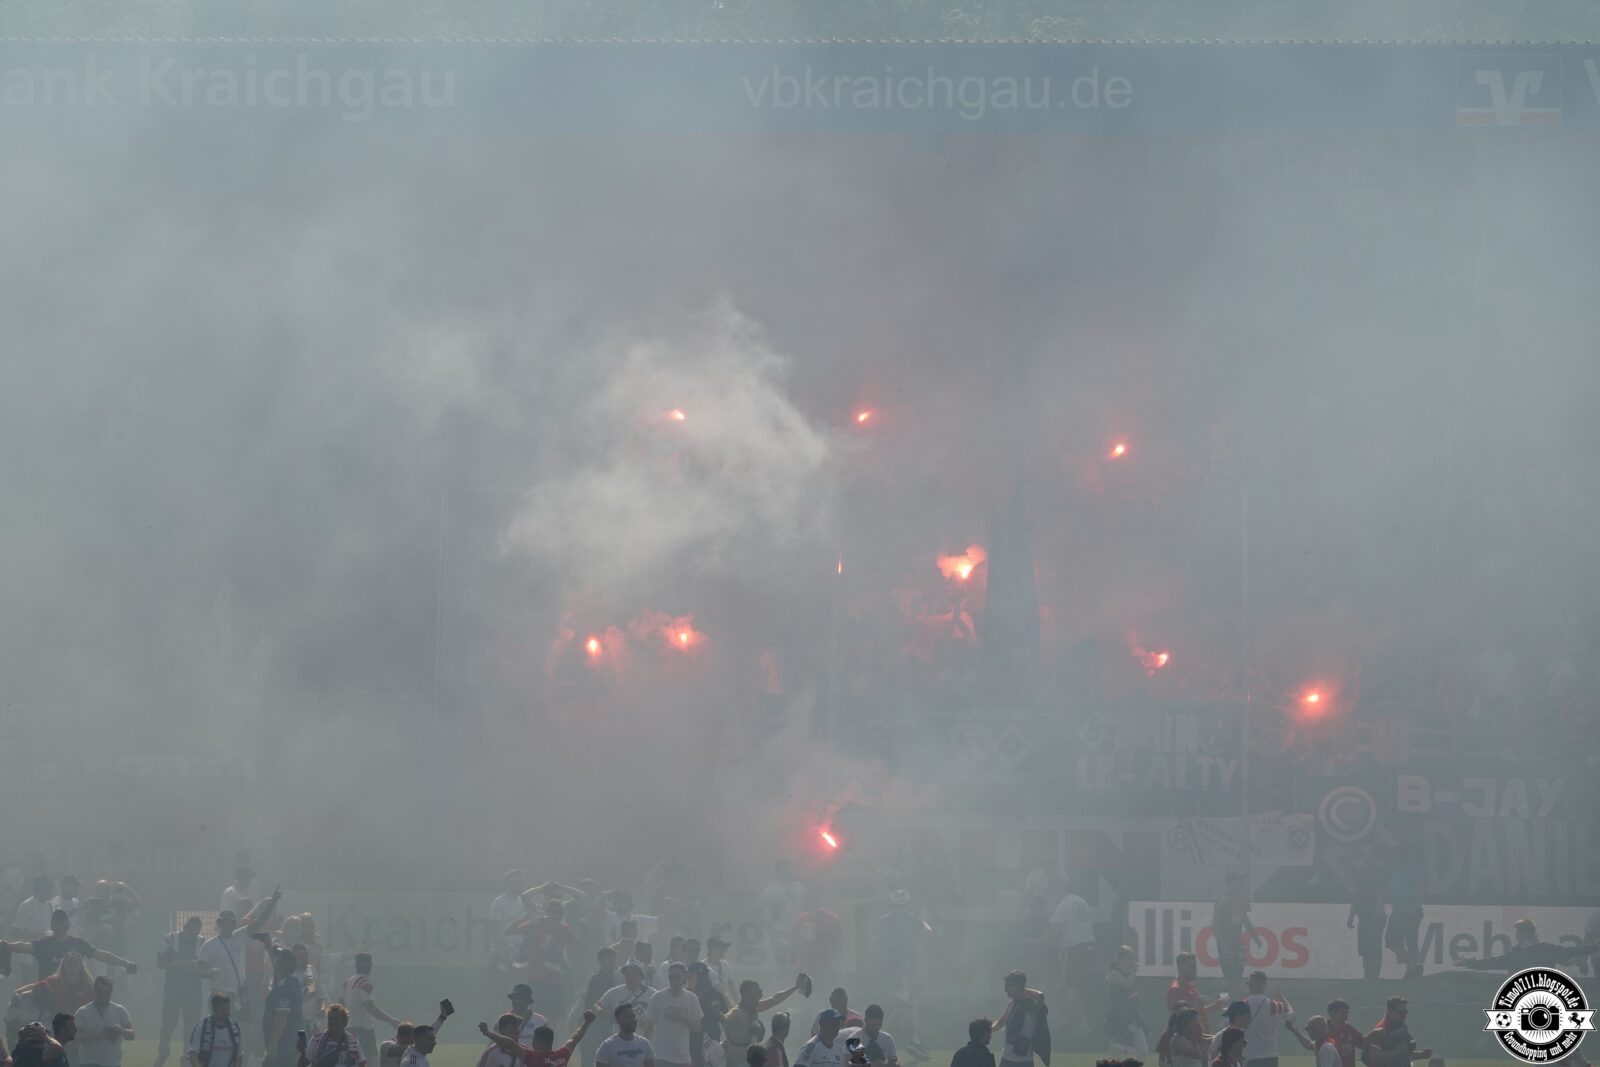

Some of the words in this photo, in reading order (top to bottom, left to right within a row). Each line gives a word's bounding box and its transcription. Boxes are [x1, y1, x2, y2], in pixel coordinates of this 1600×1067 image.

[2, 54, 118, 106] ank
[138, 54, 456, 123] Kraichgau
[740, 64, 1134, 121] vbkraichgau.de
[1396, 774, 1568, 818] B-JAY
[326, 901, 491, 952] Kraich
